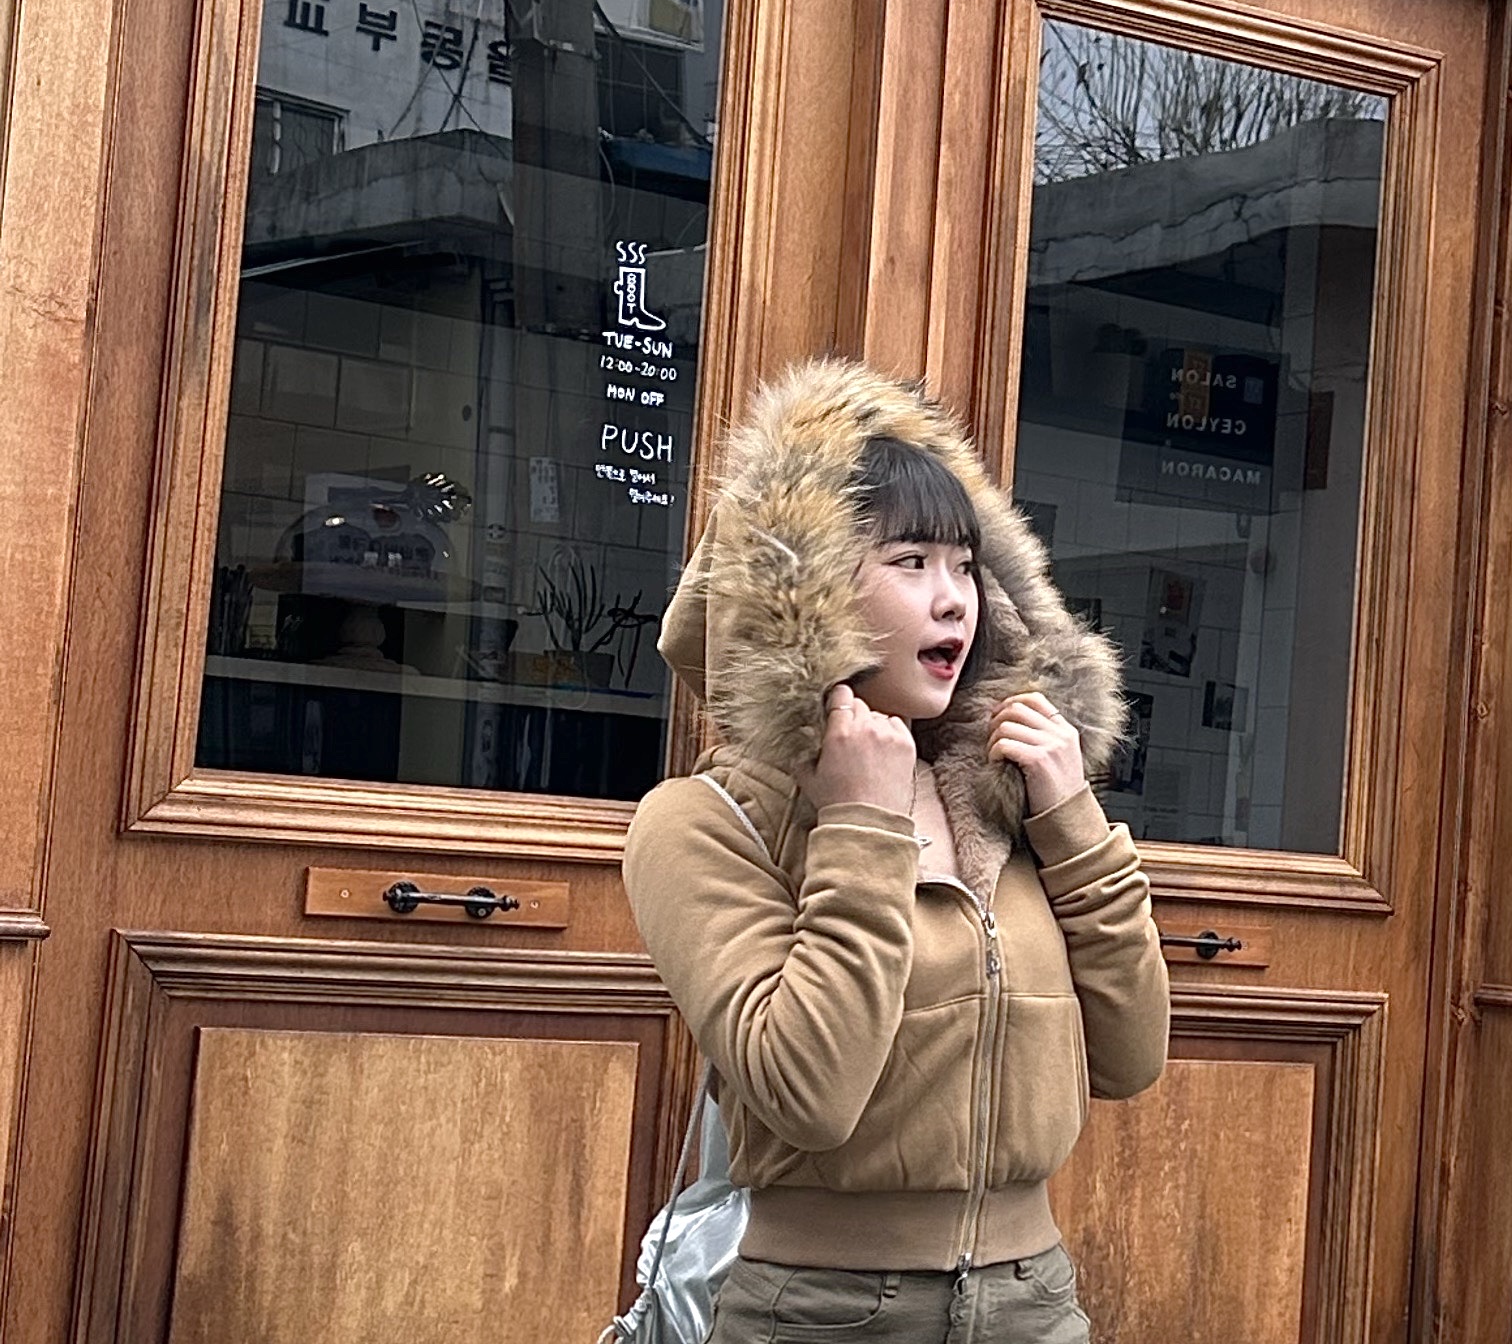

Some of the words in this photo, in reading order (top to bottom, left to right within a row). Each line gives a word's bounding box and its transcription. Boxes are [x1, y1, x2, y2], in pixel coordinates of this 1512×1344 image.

[606, 383, 636, 402] MON
[640, 391, 665, 407] OFF
[600, 423, 675, 463] PUSH
